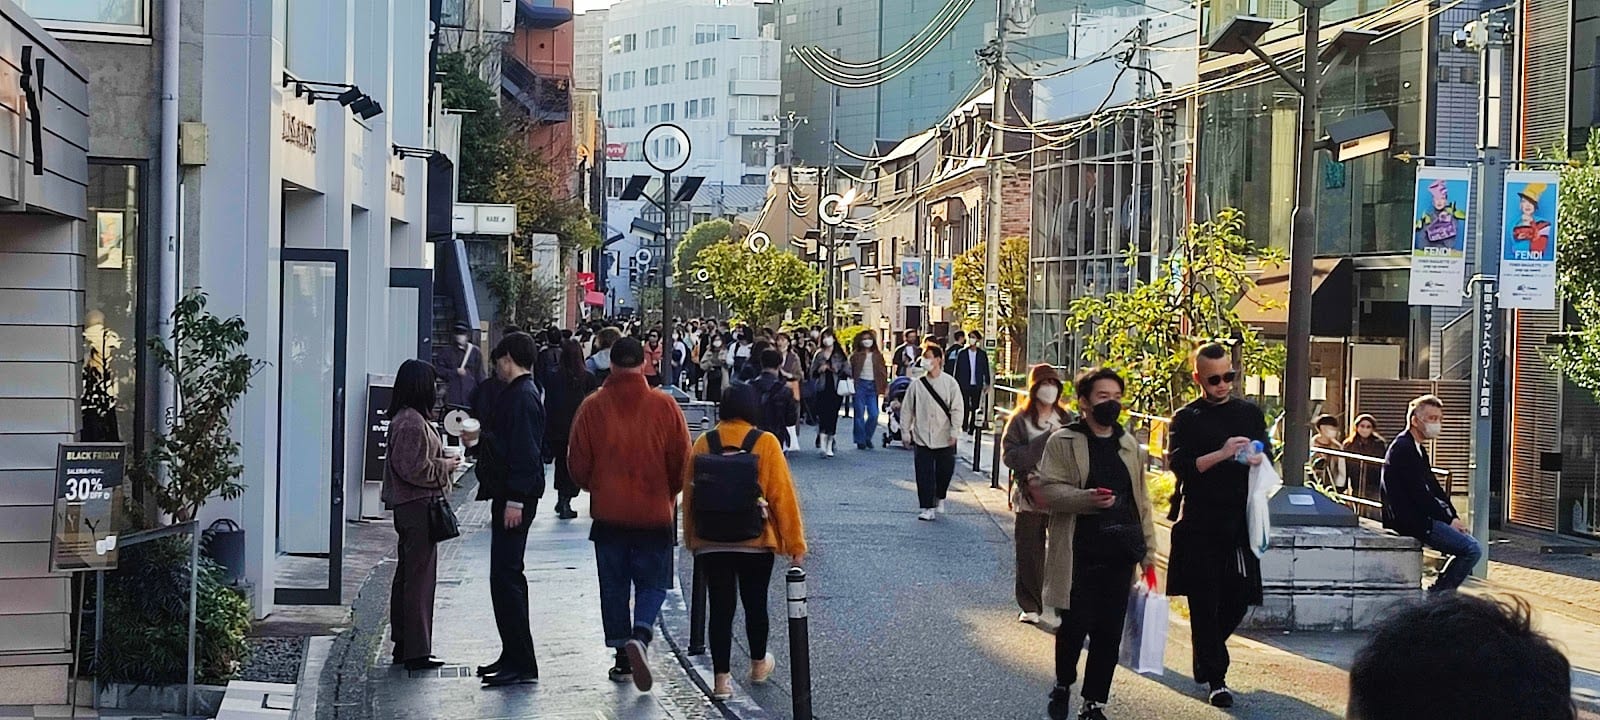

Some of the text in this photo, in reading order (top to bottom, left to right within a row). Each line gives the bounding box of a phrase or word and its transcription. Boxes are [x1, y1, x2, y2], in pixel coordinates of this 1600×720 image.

[1424, 247, 1452, 256] FENDI
[1515, 250, 1543, 259] FENDI
[66, 451, 120, 460] BLACK FRIDAY
[65, 478, 103, 500] 30%
[89, 491, 103, 499] OFF
